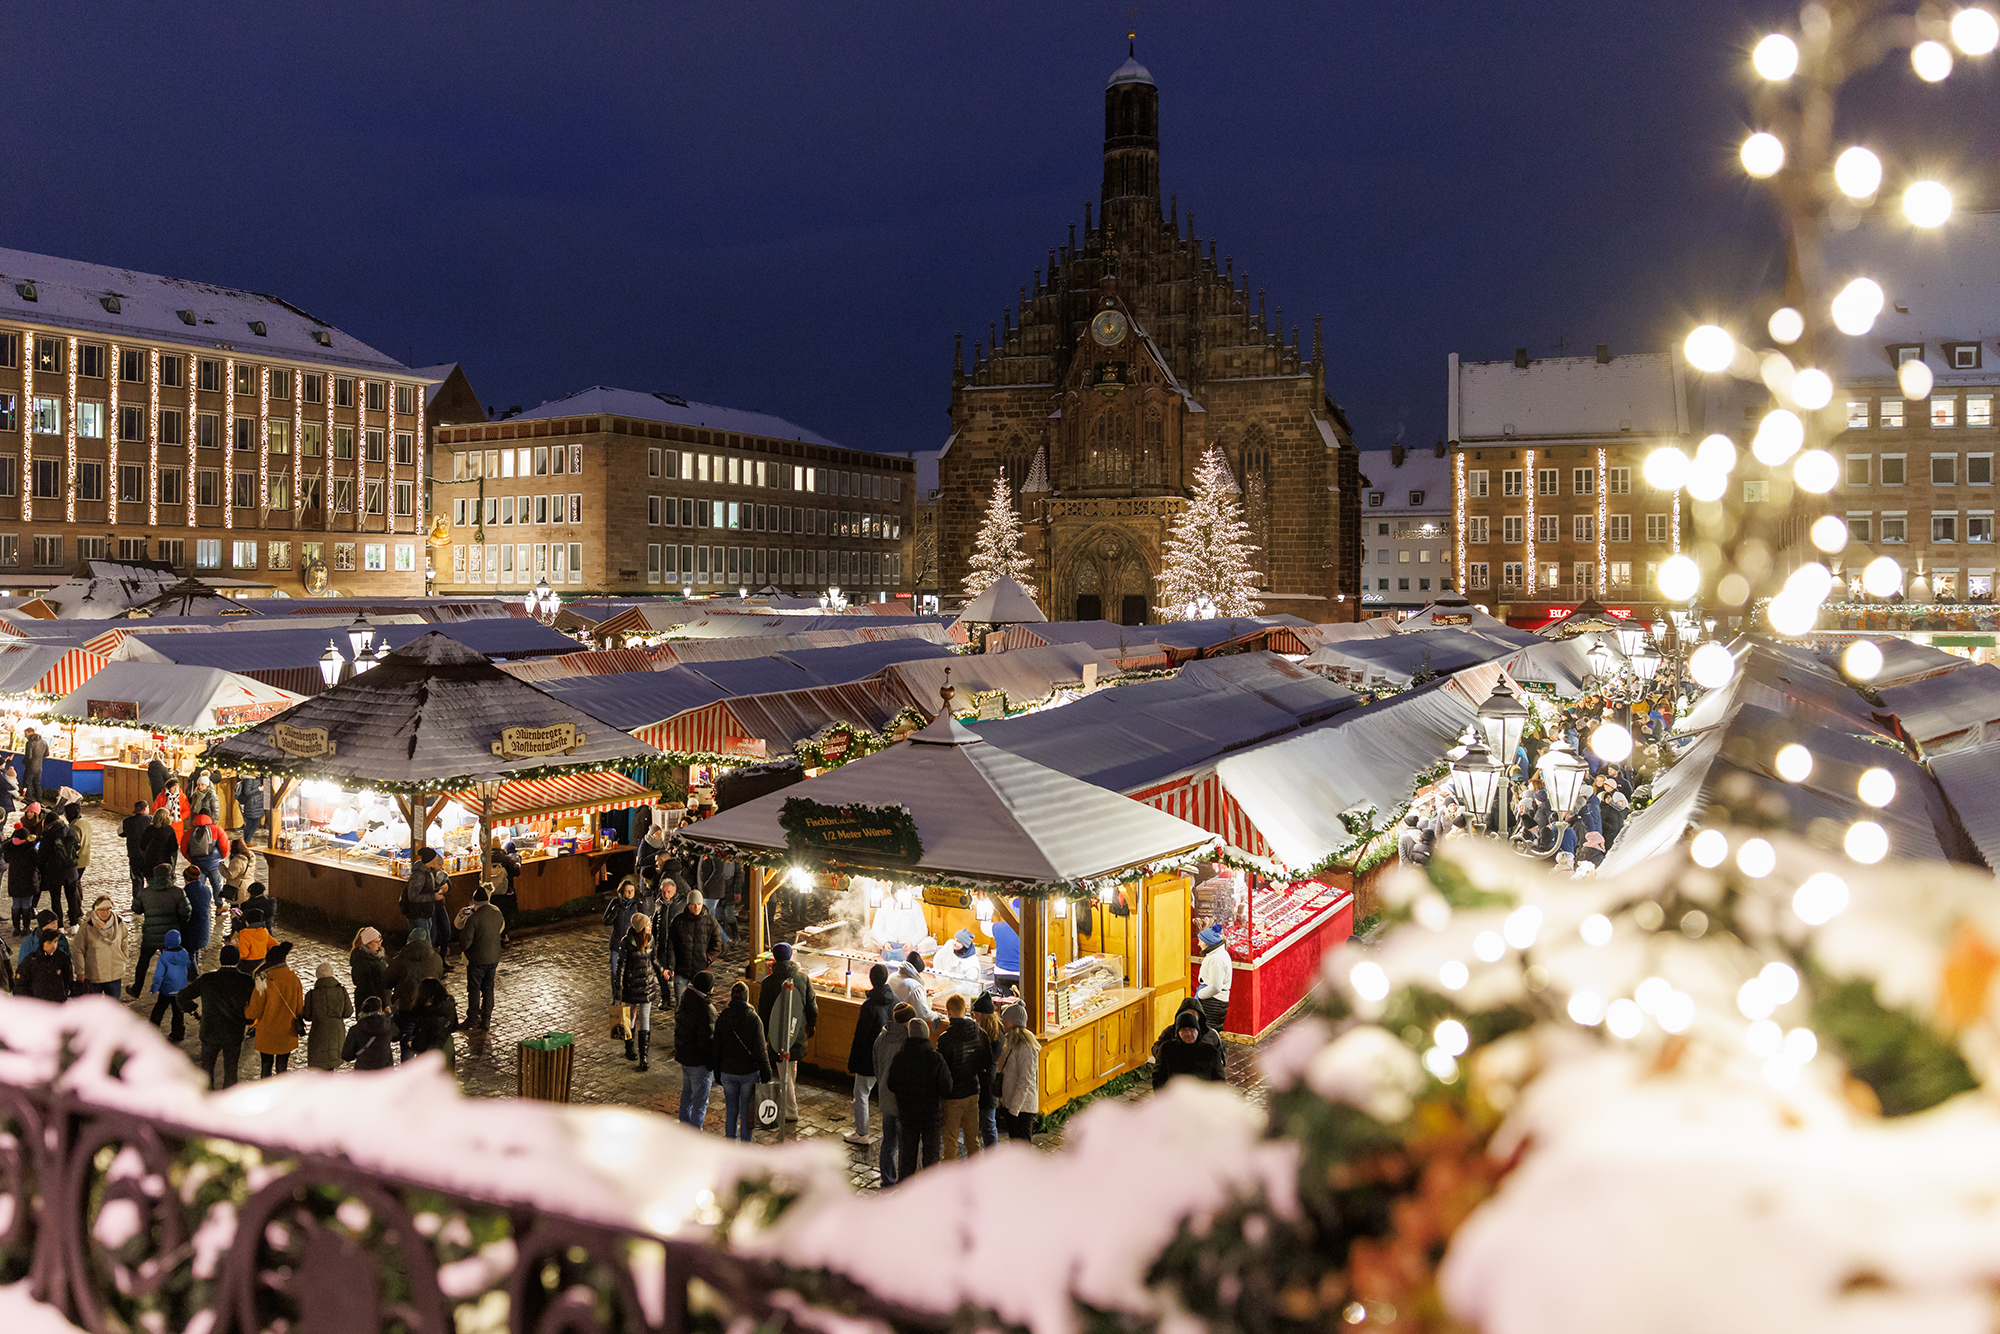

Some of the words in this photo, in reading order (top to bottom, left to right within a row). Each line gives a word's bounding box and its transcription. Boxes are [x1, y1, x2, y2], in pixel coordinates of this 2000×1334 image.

[1549, 609, 1572, 618] BLO
[284, 726, 318, 742] Nürnberger
[516, 728, 562, 741] Nürnberger
[822, 831, 837, 841] 1/2
[837, 830, 862, 840] Meter
[861, 828, 893, 838] Würste
[761, 1106, 776, 1119] JD
